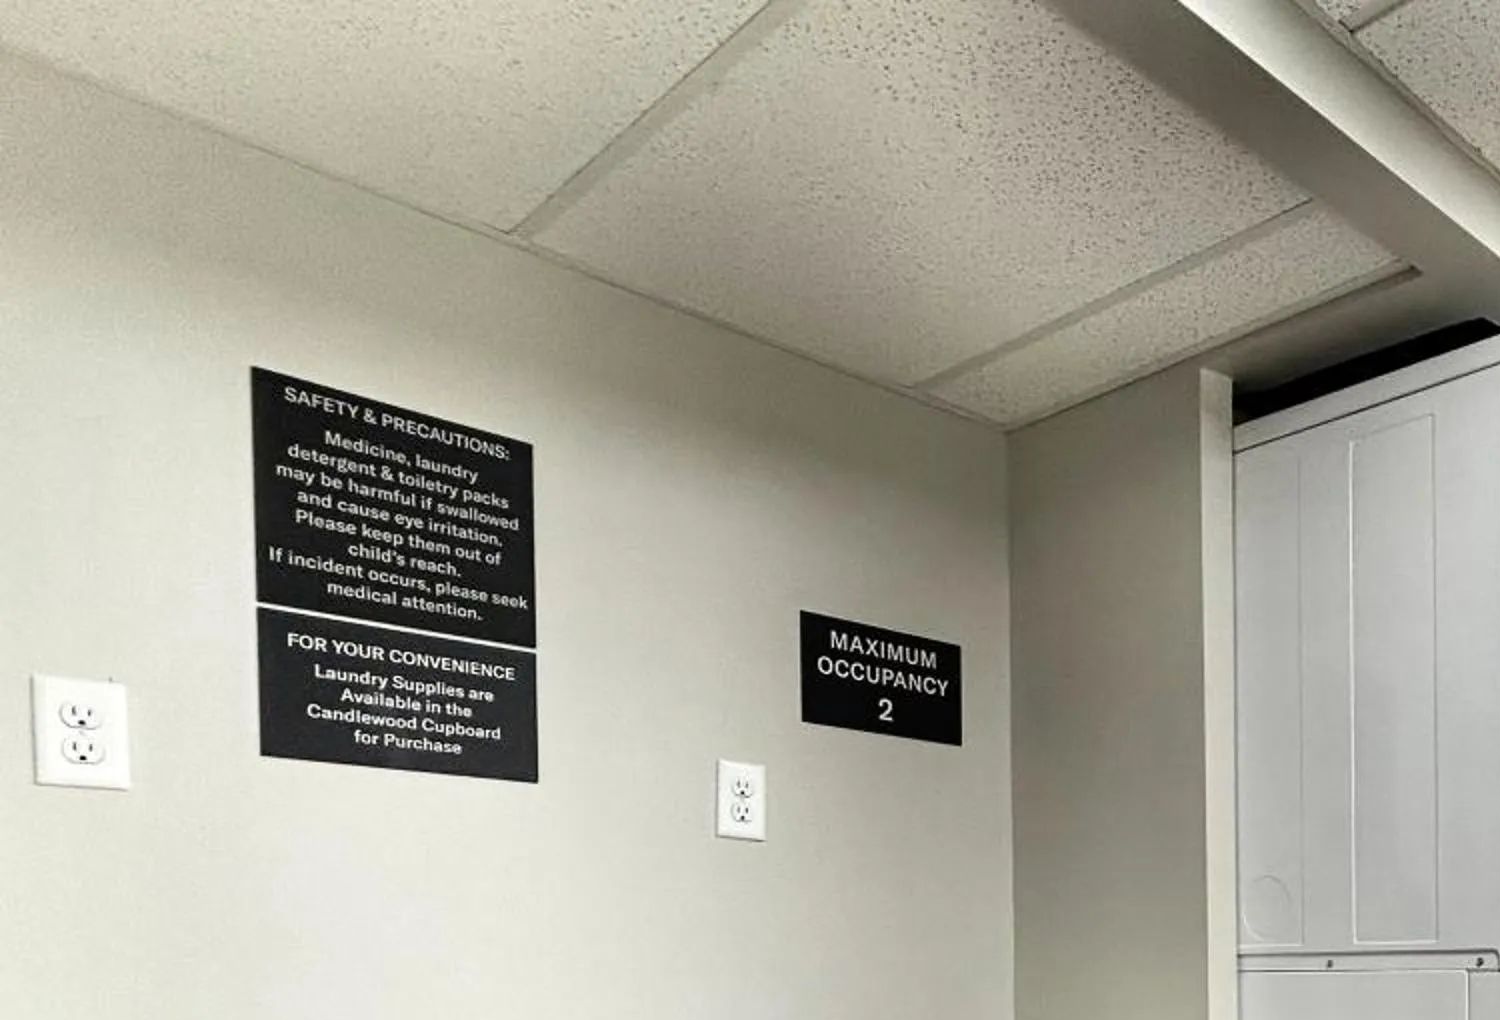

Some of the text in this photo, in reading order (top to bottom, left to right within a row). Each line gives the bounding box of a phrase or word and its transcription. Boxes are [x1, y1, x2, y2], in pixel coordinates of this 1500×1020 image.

[284, 386, 511, 461] SAFETY & PRECAUTIONS:
[287, 443, 509, 509] detergent & toiletry packs
[325, 430, 479, 485] Medicine, laundry
[275, 464, 519, 531] may be harmful if swallowed
[297, 491, 333, 509] and
[337, 501, 390, 522] cause
[394, 513, 424, 529] eye
[295, 508, 502, 566] Please keep them out of
[268, 545, 283, 563] If
[287, 549, 363, 579] incident
[435, 582, 489, 603] please
[491, 593, 529, 610] seek
[347, 543, 462, 577] child's reach.
[326, 582, 484, 621] medical attention.
[287, 632, 517, 681] FOR YOUR CONVENIENCE
[830, 630, 937, 669] MAXIMUM
[314, 663, 495, 703] Laundry Supplies are
[817, 655, 949, 697] OCCUPANCY
[306, 702, 502, 741] Candlewood Cupboard
[341, 687, 473, 719] Available in the
[878, 698, 893, 721] 2
[353, 729, 463, 755] for Purchase
